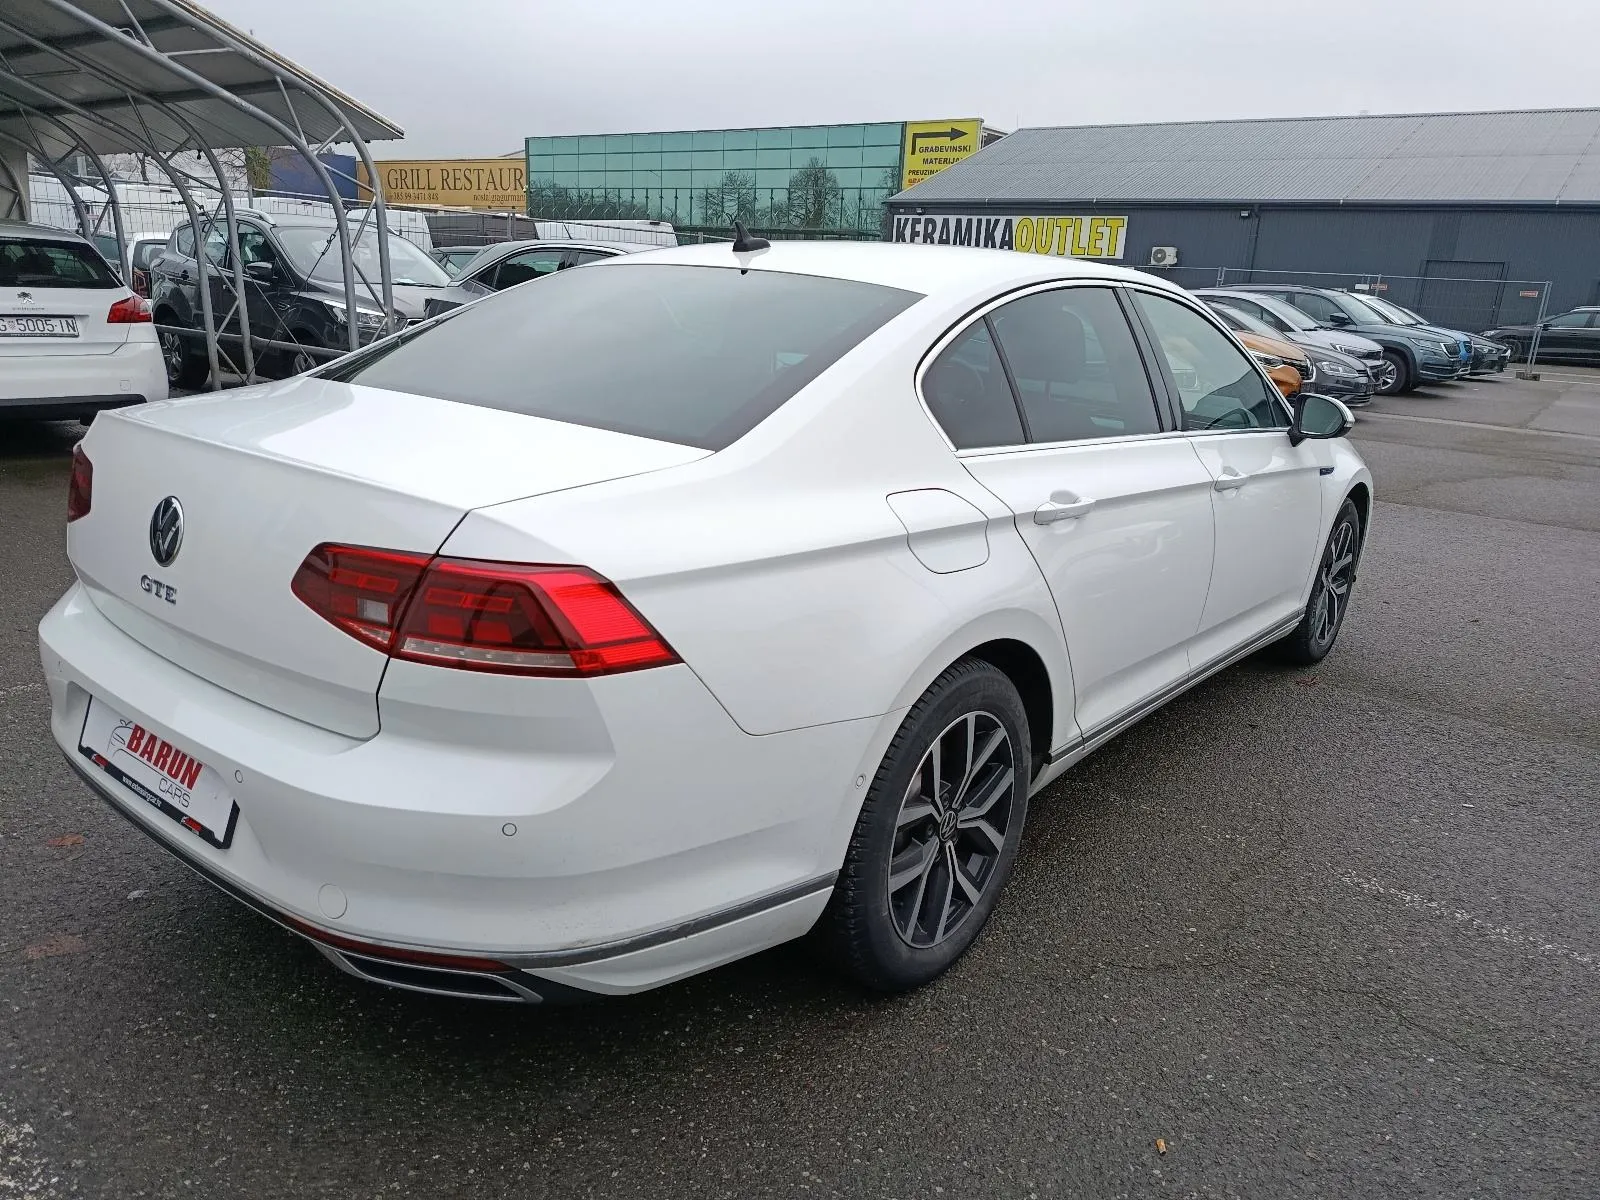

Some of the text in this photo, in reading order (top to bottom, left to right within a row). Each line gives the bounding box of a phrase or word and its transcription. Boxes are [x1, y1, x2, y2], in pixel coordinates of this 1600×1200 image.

[918, 145, 971, 154] GRAĐEVINSKI
[387, 168, 525, 191] GRILL RESTAUR
[140, 574, 177, 605] GTE
[126, 723, 203, 790] BARUN
[158, 777, 191, 808] CARS
